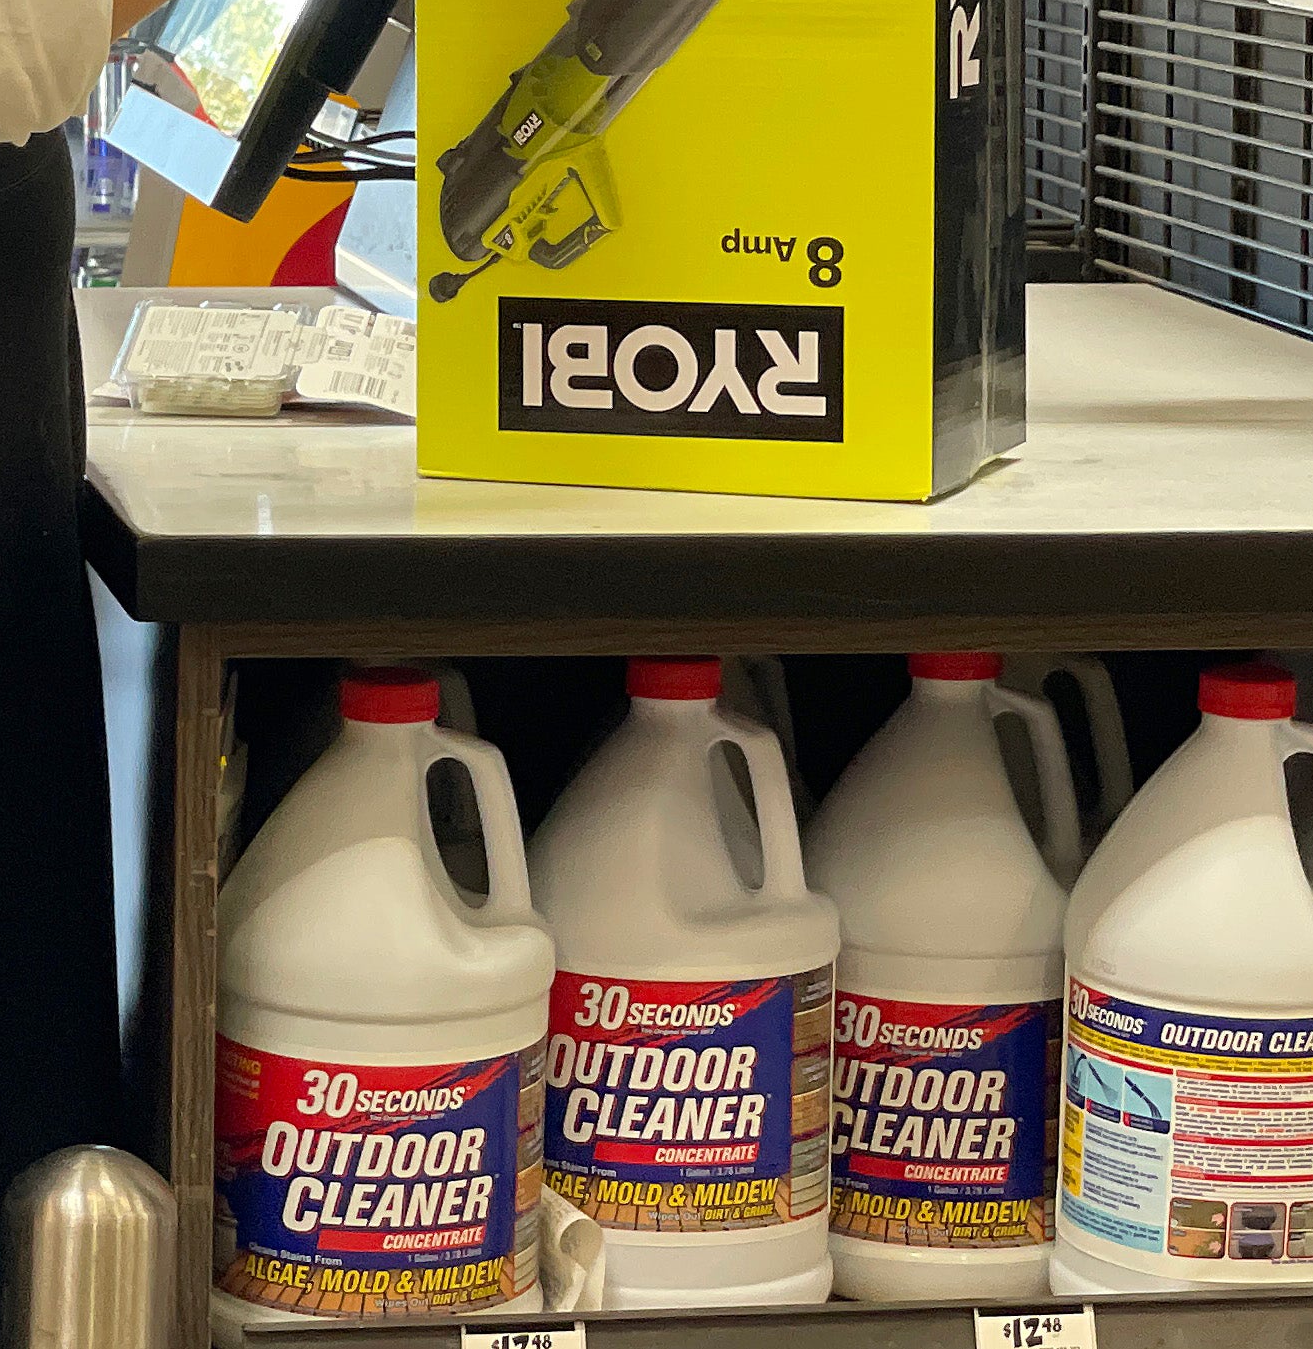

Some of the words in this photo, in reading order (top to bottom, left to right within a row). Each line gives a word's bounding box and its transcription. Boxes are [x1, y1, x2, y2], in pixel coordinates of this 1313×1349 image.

[513, 113, 542, 146] RYOBI
[722, 229, 795, 262] Amp
[806, 236, 844, 288] 8
[522, 321, 827, 418] RYOBI
[575, 983, 629, 1030] 30
[627, 1003, 735, 1027] SECONDS
[836, 1001, 880, 1048] 30
[879, 1023, 984, 1050] SECONDS
[1087, 1007, 1144, 1035] SECONDS
[1161, 1023, 1263, 1053] OUTDOOR
[547, 1034, 756, 1091] OUTDOOR
[835, 1057, 1005, 1112] UTDOOR
[297, 1070, 358, 1118] 30
[356, 1086, 466, 1113] SECONDS
[563, 1088, 765, 1143] CLEANER
[261, 1121, 485, 1178] OUTDOOR
[655, 1145, 756, 1163] CONCENTRATE
[832, 1103, 1016, 1160] CLEANER
[598, 1179, 662, 1206] MOLD
[669, 1184, 685, 1206] &
[693, 1178, 778, 1206] MILDEW
[905, 1164, 1006, 1181] CONCENTRATE
[282, 1175, 492, 1232] CLEANER
[851, 1193, 911, 1220] MOLD
[942, 1199, 1030, 1224] MILDEW
[383, 1227, 483, 1249] CONCENTRATE
[245, 1255, 312, 1293] ALGAE,
[321, 1269, 389, 1294] MOLD
[395, 1270, 413, 1293] &
[421, 1257, 504, 1294] MILDEW
